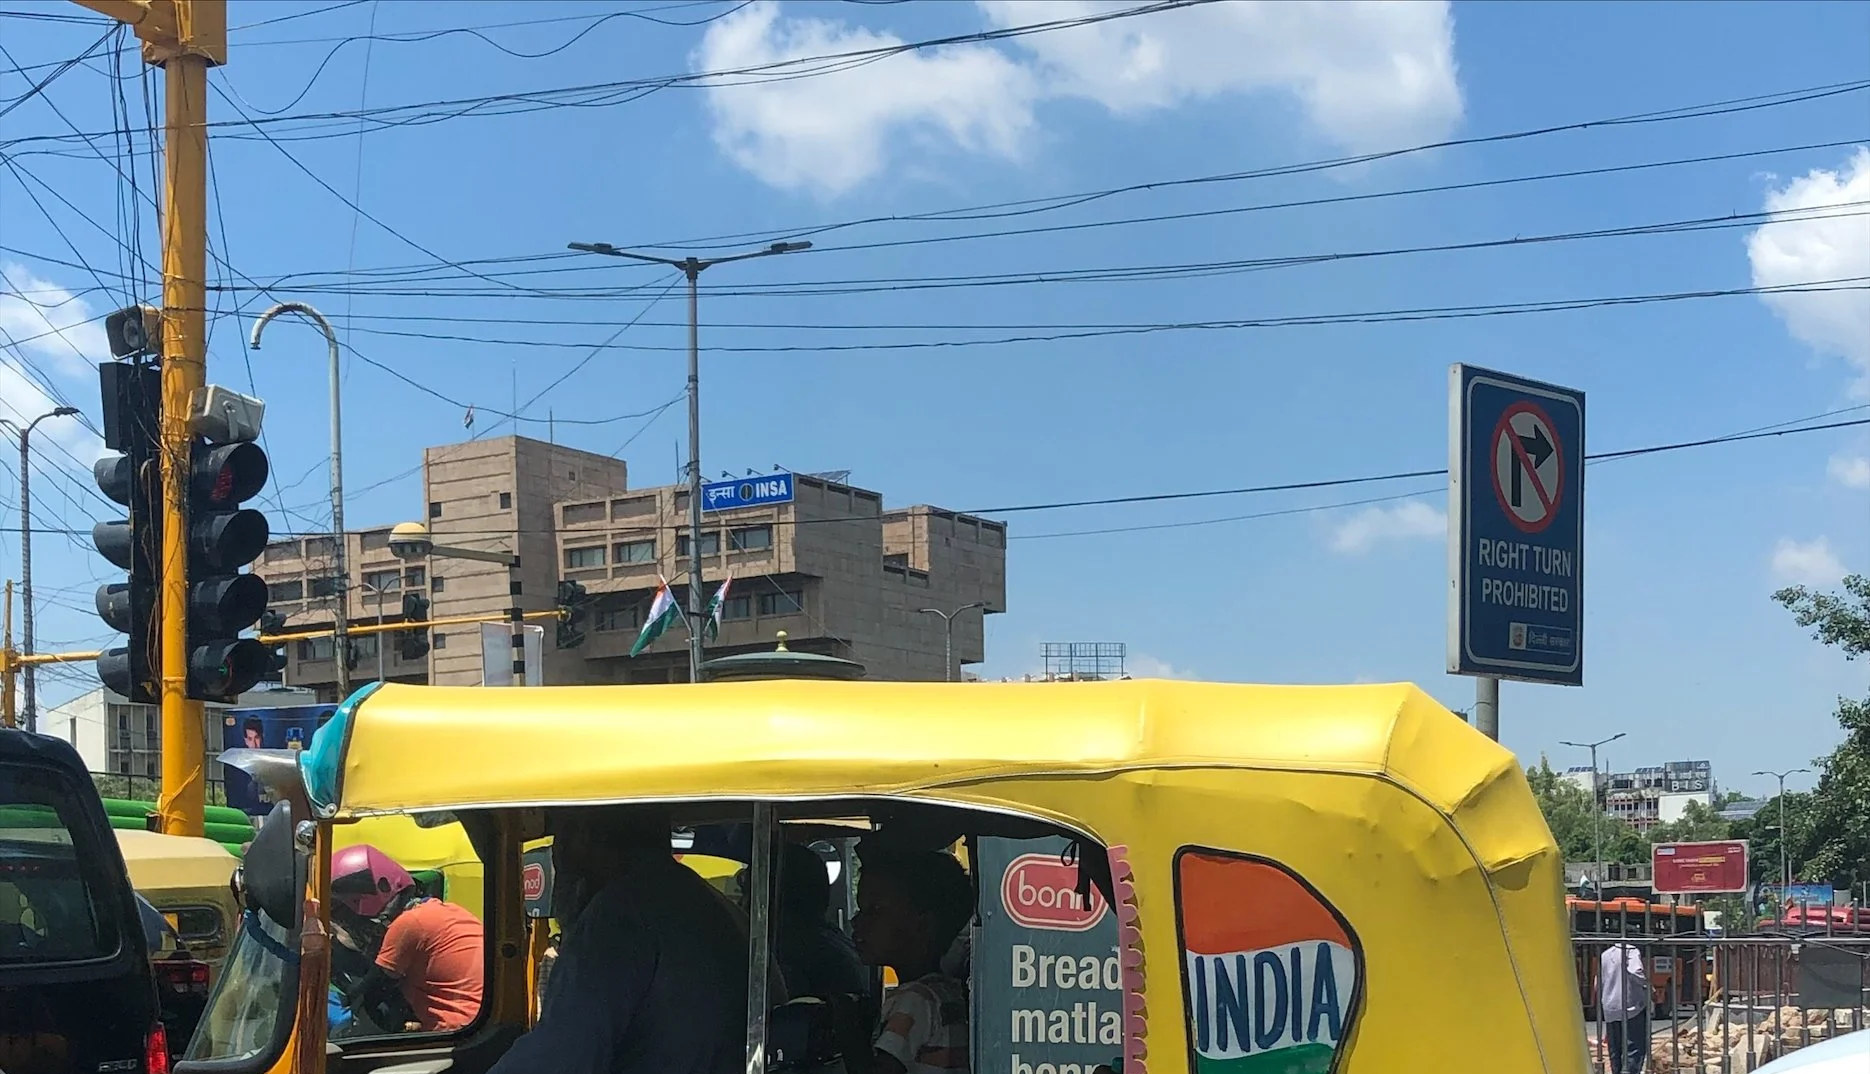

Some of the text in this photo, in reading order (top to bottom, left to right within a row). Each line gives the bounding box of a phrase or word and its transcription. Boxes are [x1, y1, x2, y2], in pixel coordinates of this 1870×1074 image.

[755, 480, 787, 498] INSA
[1479, 538, 1572, 577] RIGHT TURN
[1482, 578, 1568, 613] PROHIBITED
[1011, 945, 1123, 990] Bread
[1195, 942, 1340, 1052] INDIA
